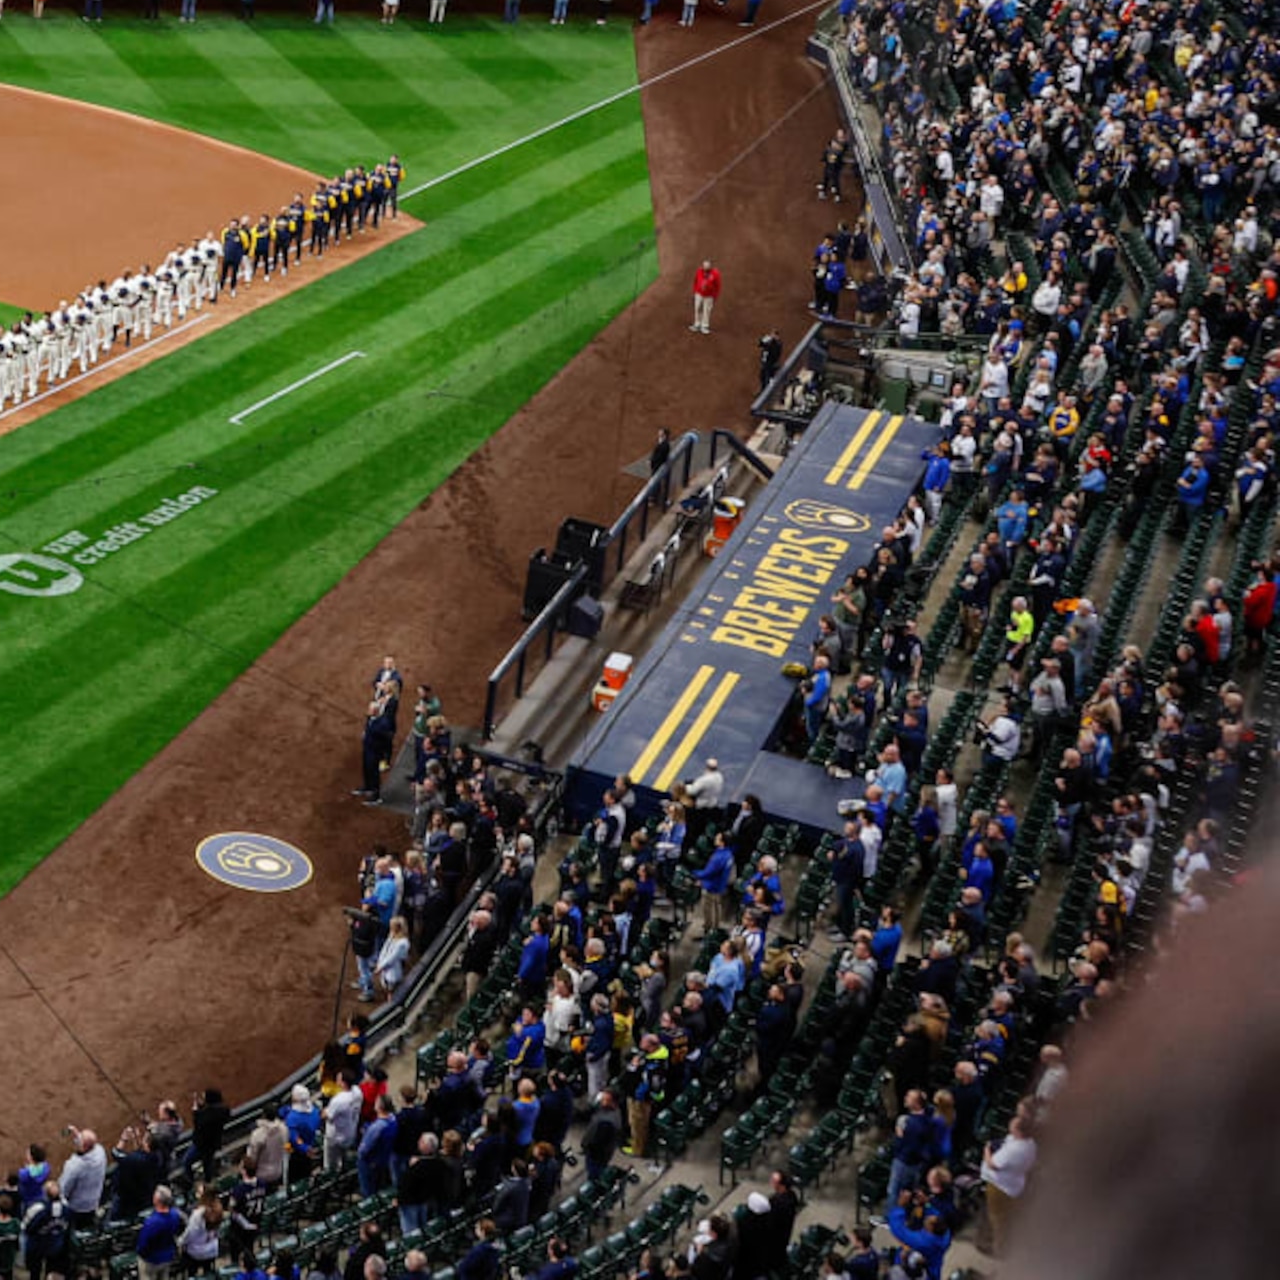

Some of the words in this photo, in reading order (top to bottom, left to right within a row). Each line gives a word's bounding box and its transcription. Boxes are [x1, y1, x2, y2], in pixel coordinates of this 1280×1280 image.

[42, 529, 91, 555] uw
[73, 520, 152, 566] credit
[138, 484, 219, 527] union
[709, 526, 851, 658] BREWERS
